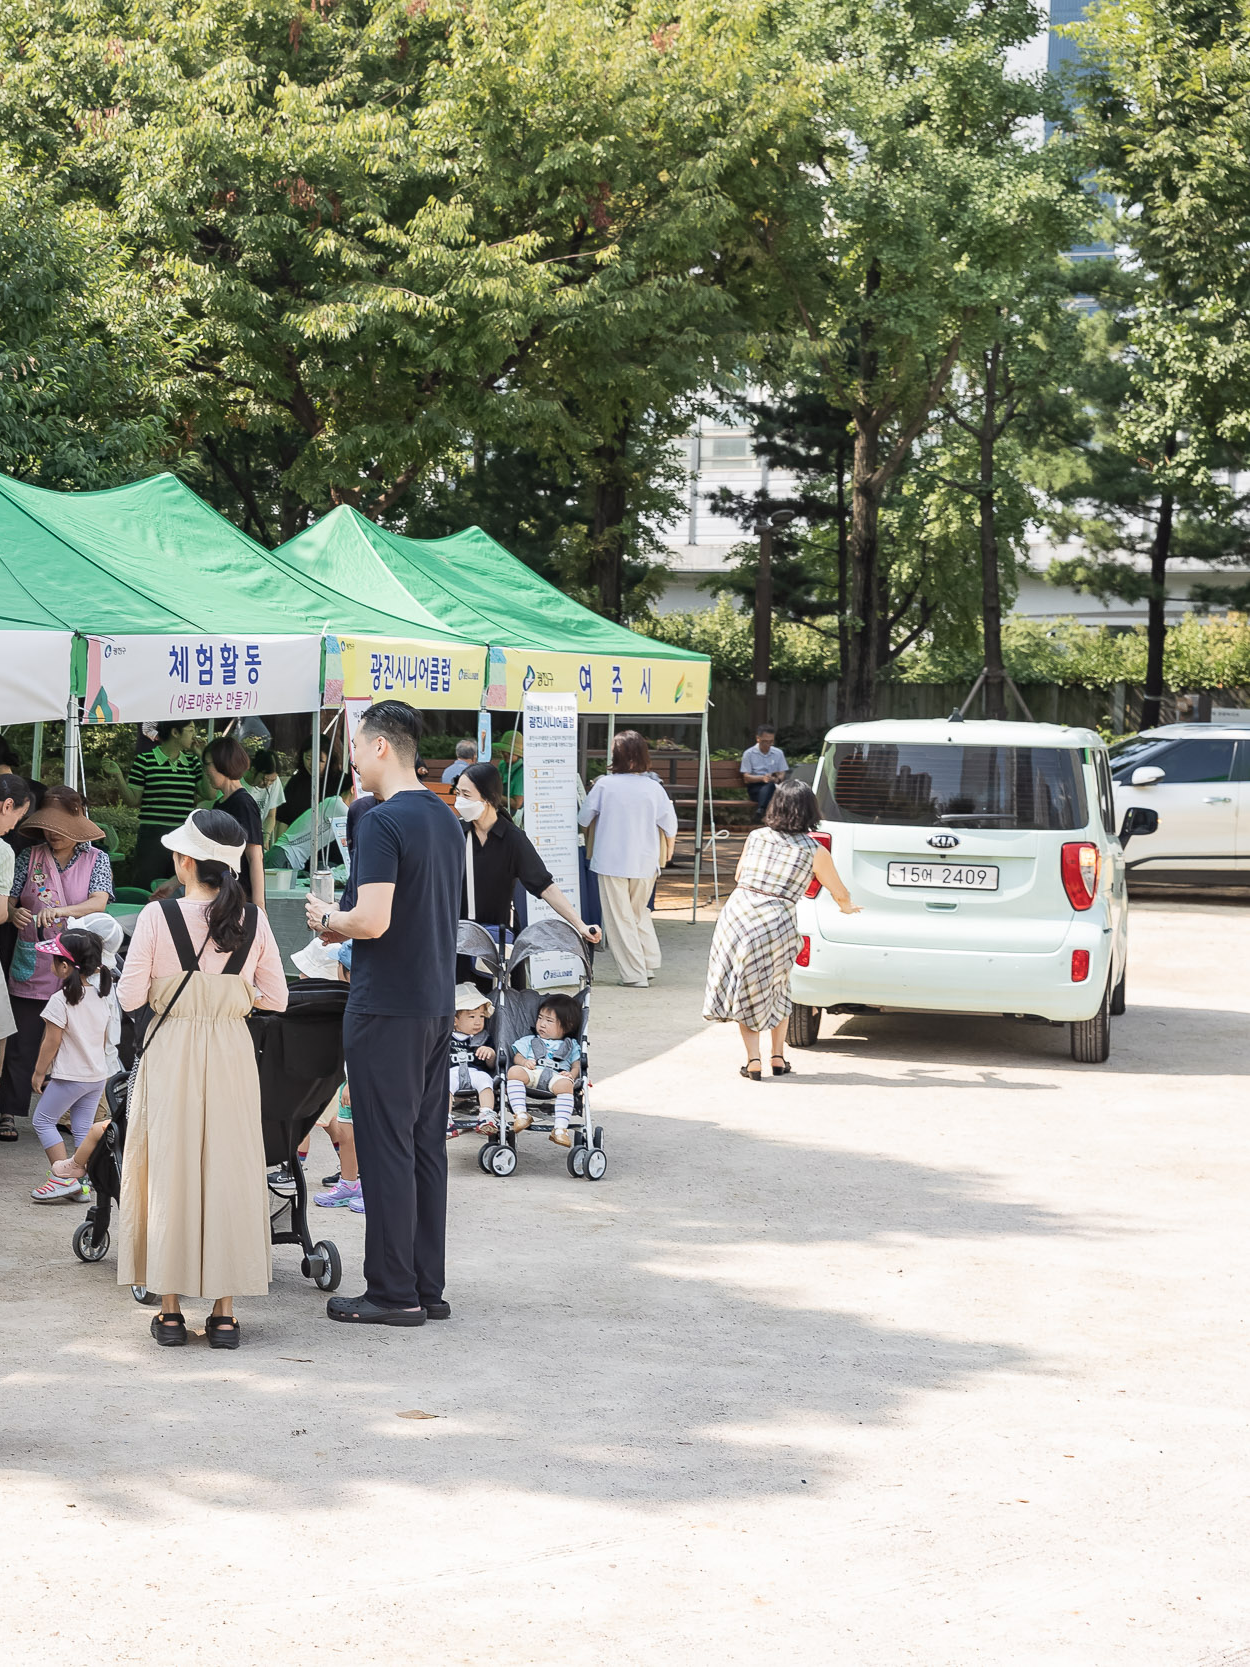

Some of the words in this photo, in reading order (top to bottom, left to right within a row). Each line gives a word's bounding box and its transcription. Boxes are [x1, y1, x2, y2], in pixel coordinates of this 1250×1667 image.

[168, 642, 263, 686] 체험활동
[370, 653, 452, 693] 광진시니어클럽
[536, 671, 554, 687] 광진구
[528, 716, 575, 729] 광진시니어클럽
[932, 836, 956, 847] KIA
[900, 866, 933, 883] 15어
[942, 867, 987, 885] 2409
